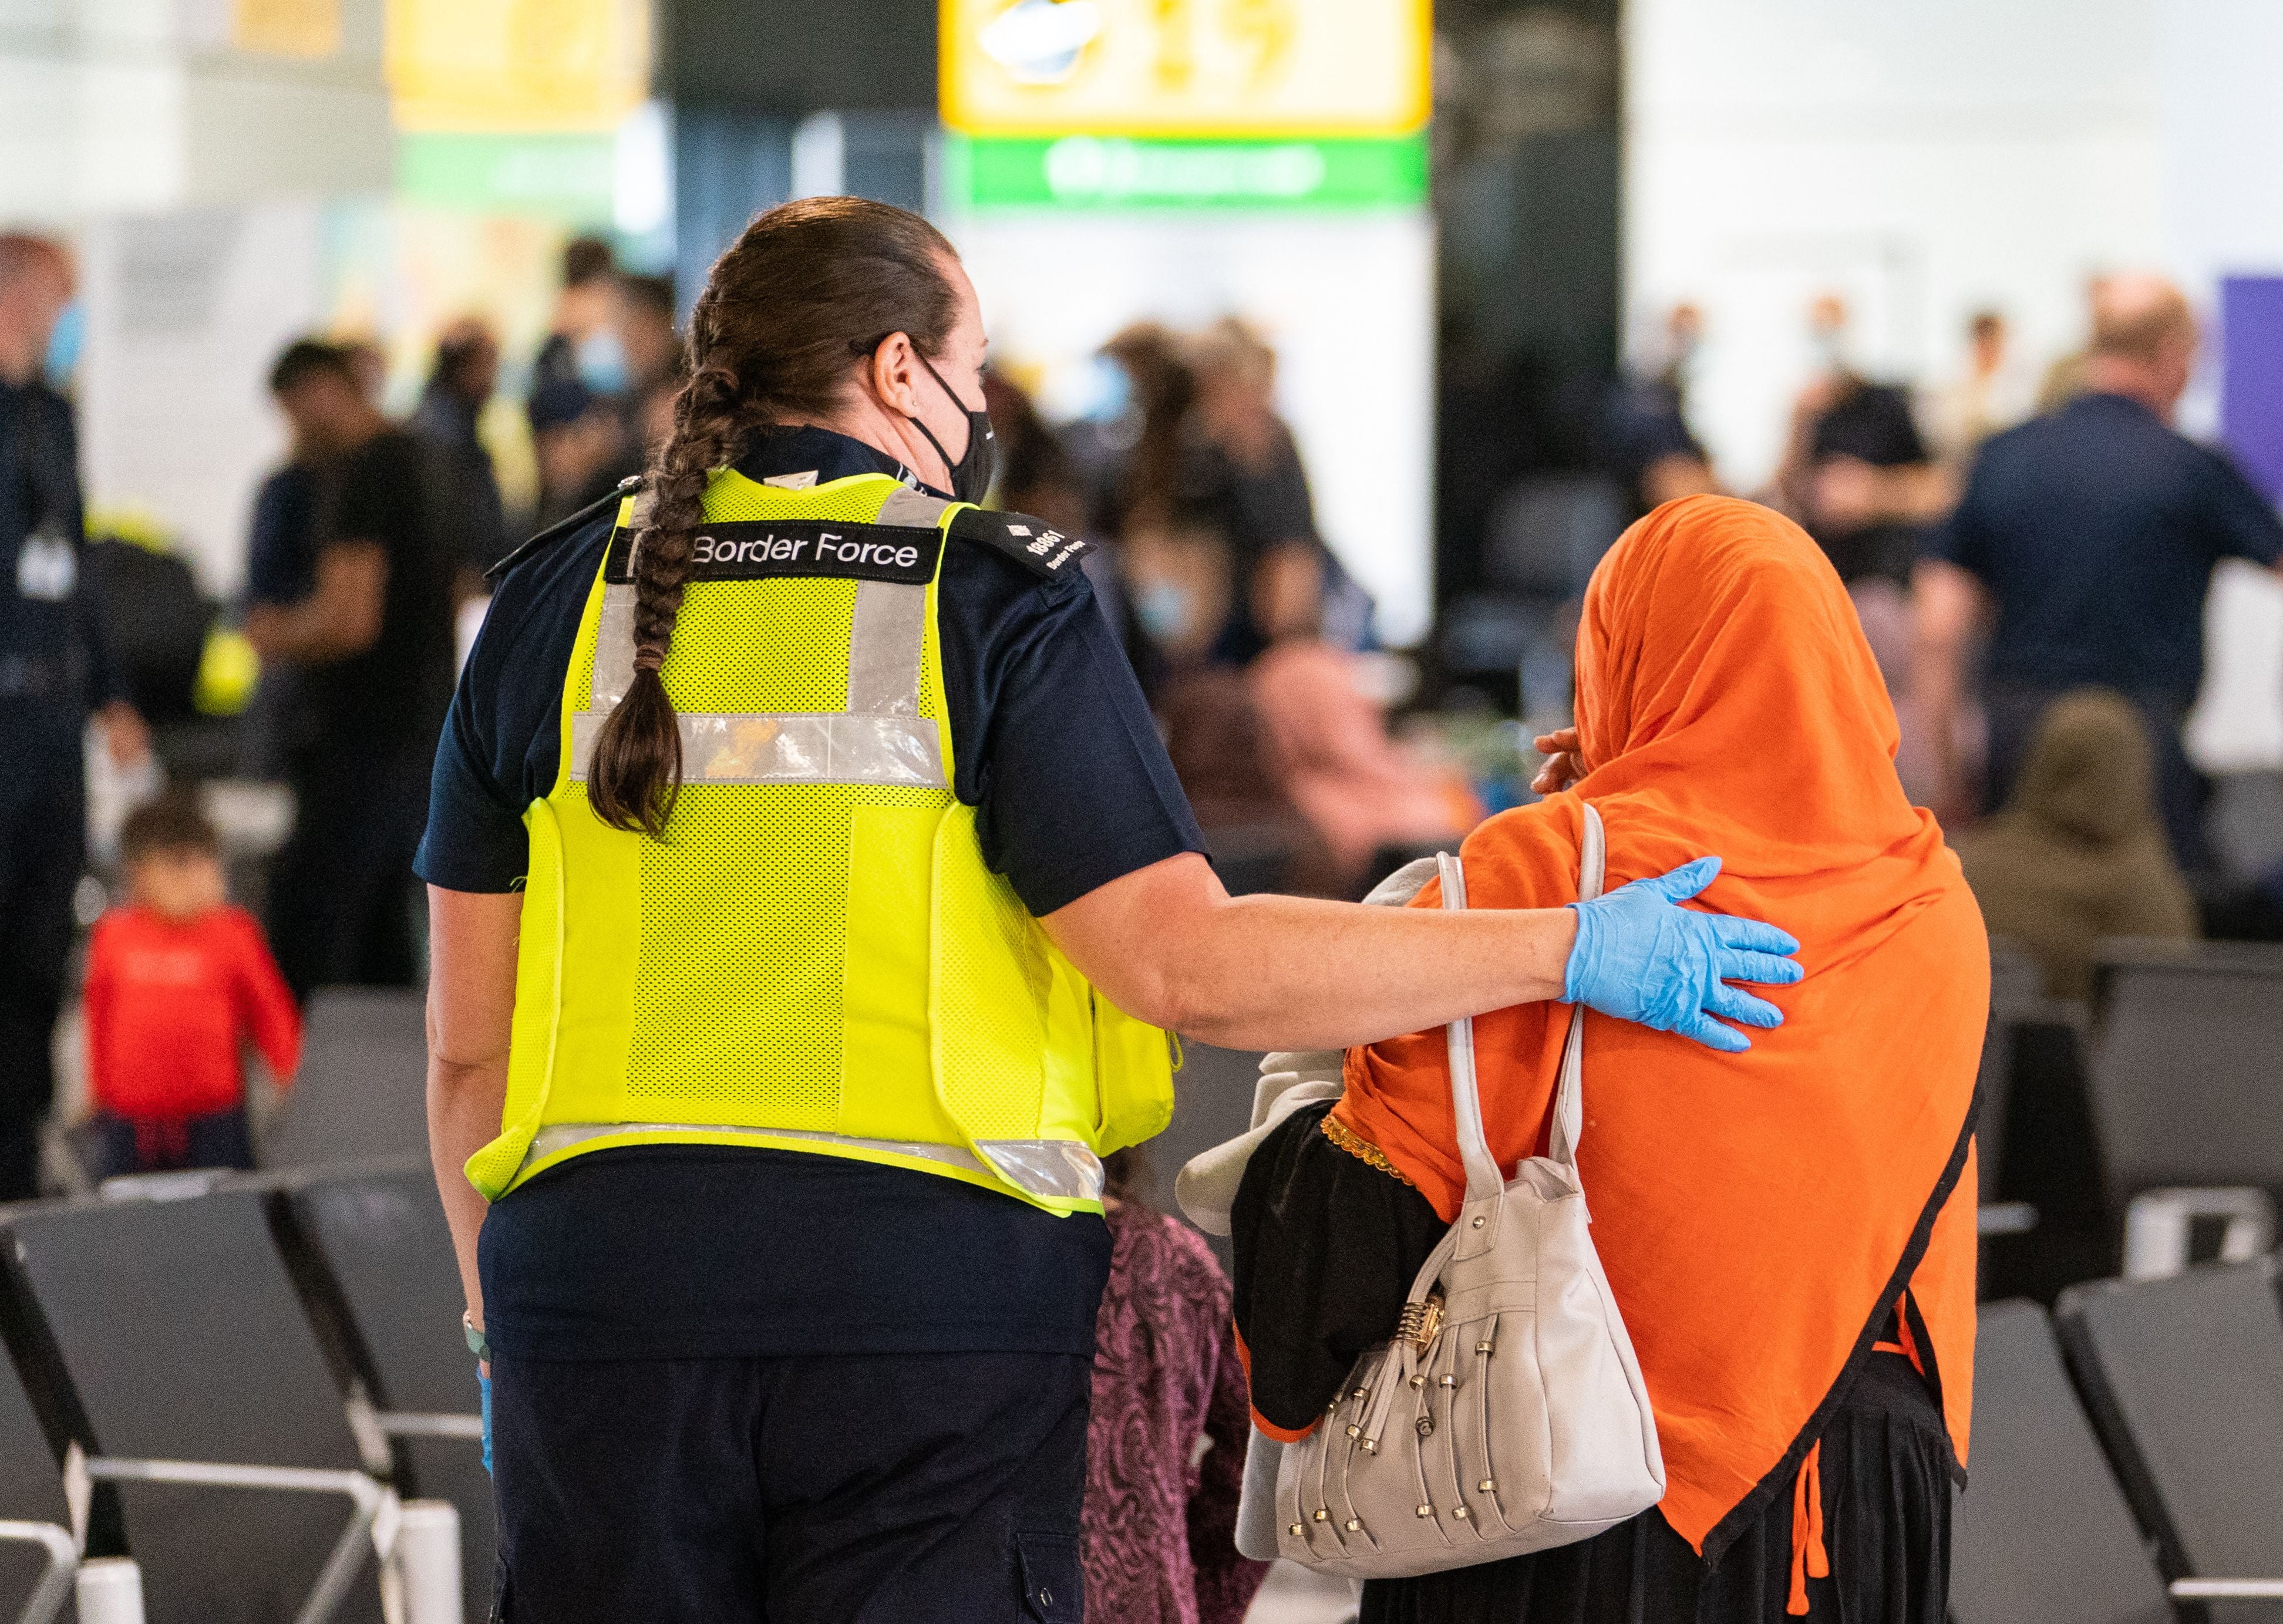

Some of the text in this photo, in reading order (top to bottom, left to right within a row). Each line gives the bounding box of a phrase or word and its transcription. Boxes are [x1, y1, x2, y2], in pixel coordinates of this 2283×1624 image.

[692, 533, 918, 568] Border Force
[1046, 550, 1070, 570] Border
